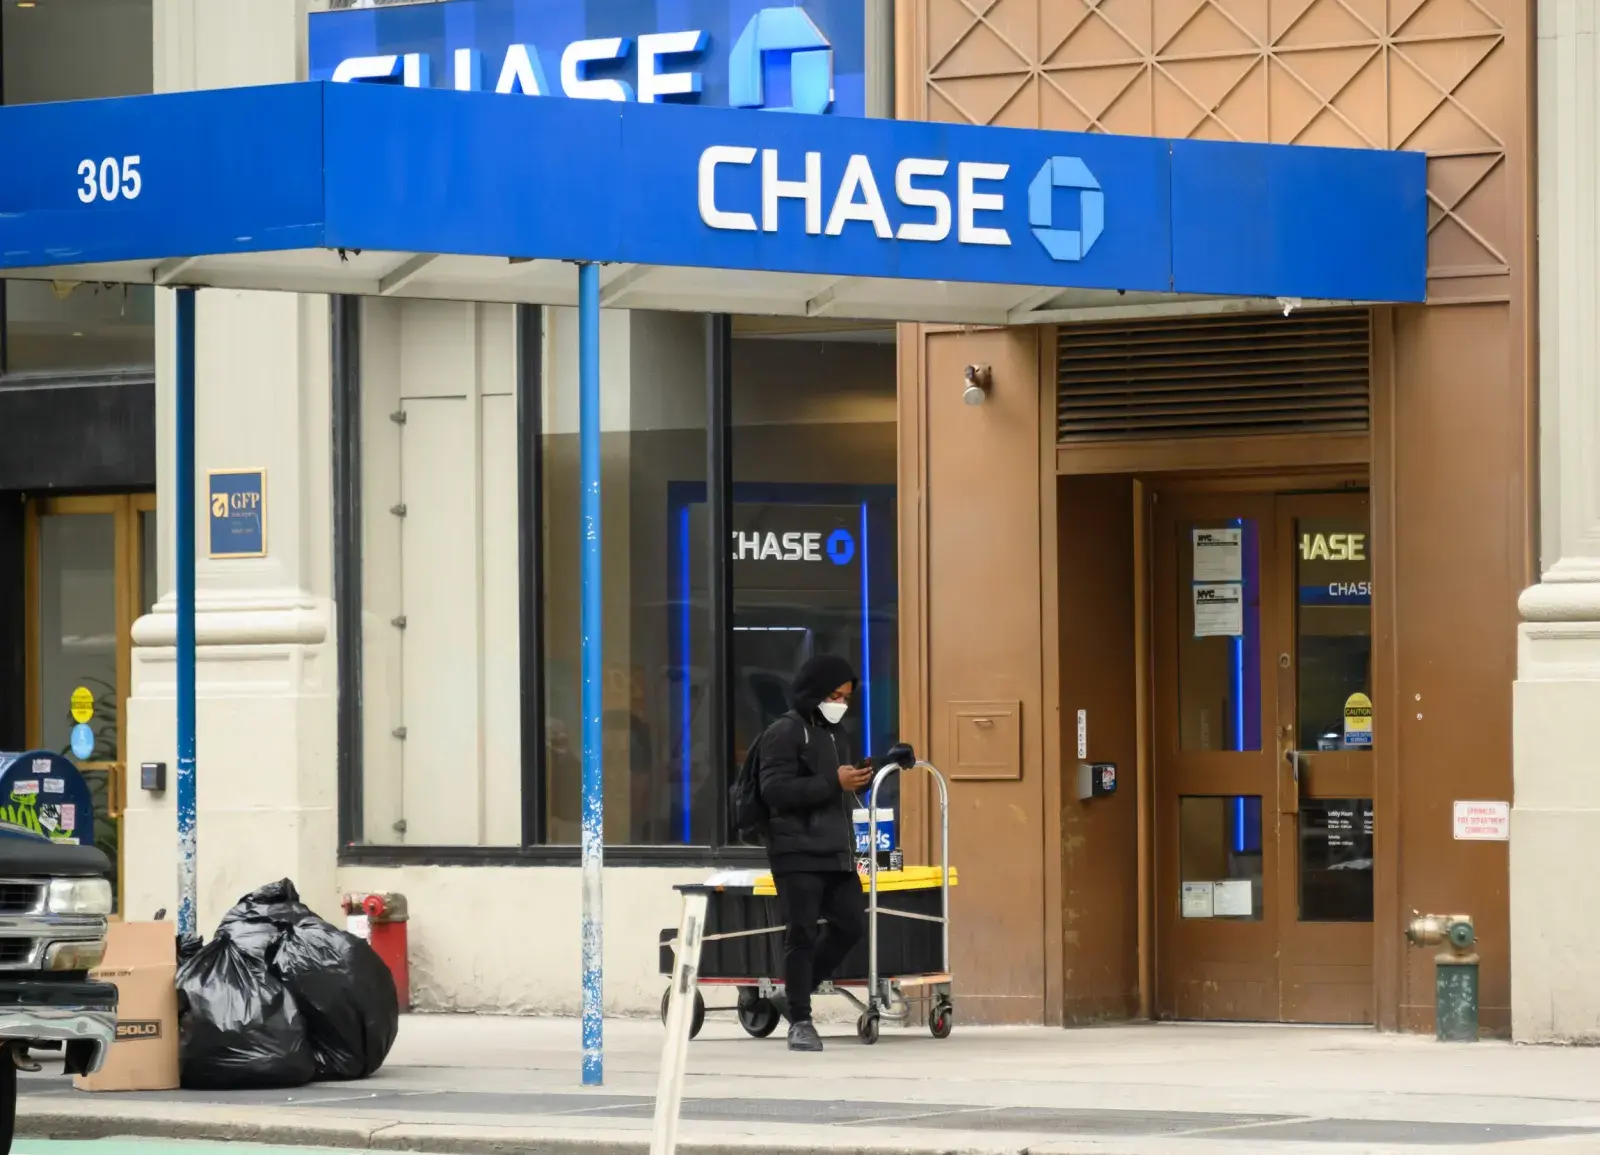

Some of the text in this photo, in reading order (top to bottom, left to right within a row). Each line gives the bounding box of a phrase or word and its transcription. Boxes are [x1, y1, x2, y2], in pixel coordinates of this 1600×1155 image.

[332, 30, 708, 103] ASE
[77, 154, 142, 203] 305
[698, 145, 1012, 245] CHASE
[231, 492, 260, 509] GFP
[1345, 708, 1372, 716] CAUTION
[116, 1024, 157, 1036] SOLO
